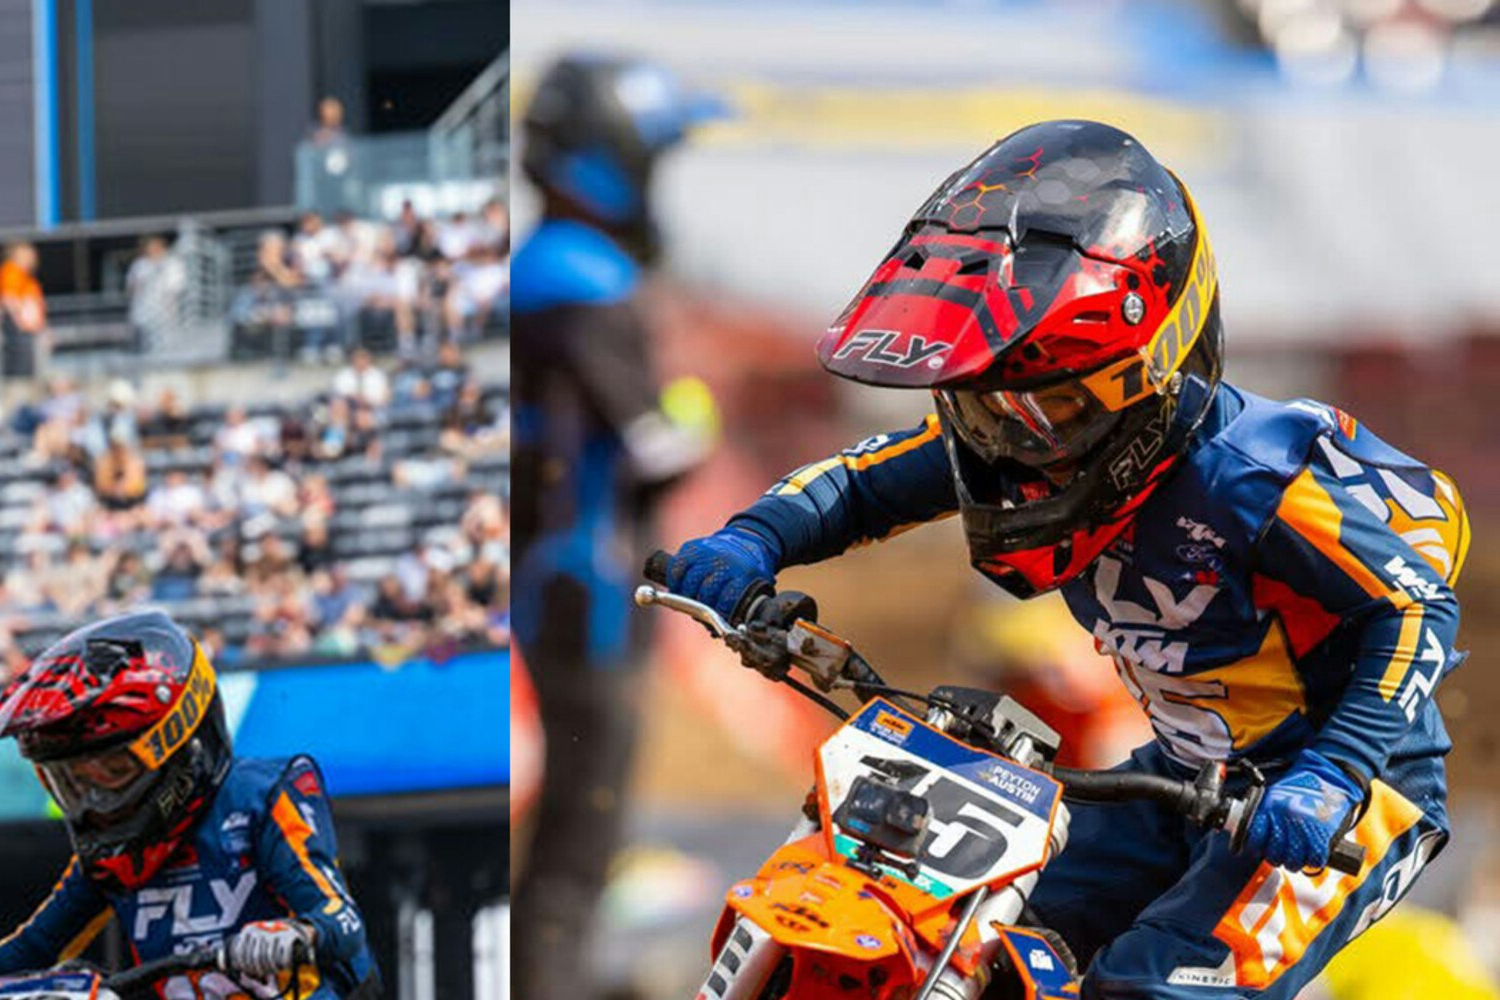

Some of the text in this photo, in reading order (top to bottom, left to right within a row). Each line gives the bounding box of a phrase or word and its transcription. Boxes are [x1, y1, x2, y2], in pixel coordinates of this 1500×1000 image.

[832, 329, 954, 369] FLY
[1108, 397, 1175, 491] FLY
[1093, 617, 1190, 673] KTM
[1398, 627, 1447, 725] FLY
[143, 664, 212, 763] 100%
[987, 775, 1037, 805] AUSTIN
[992, 764, 1042, 797] PEYTON
[133, 870, 258, 942] FLY
[1176, 971, 1233, 986] KINETIC
